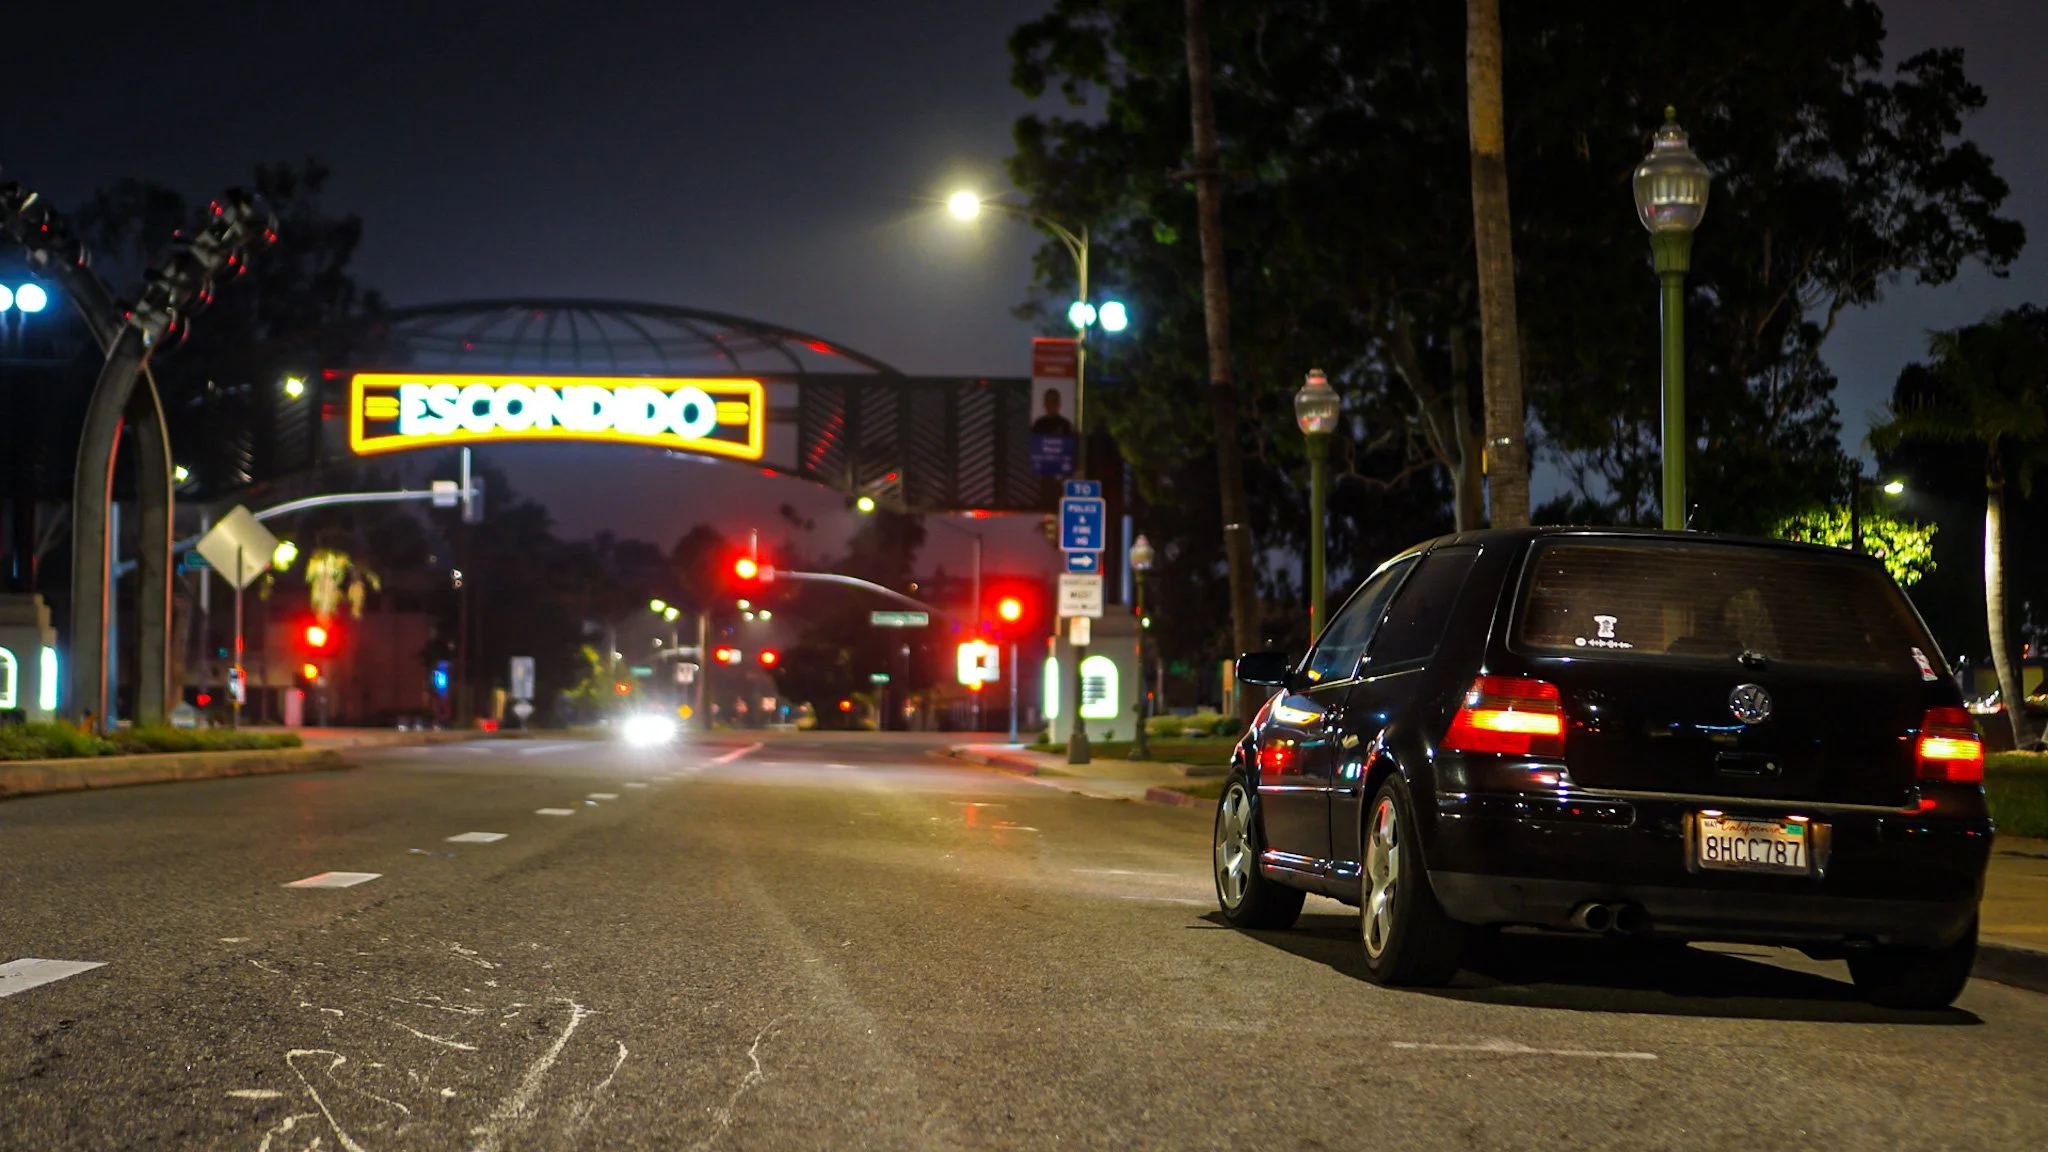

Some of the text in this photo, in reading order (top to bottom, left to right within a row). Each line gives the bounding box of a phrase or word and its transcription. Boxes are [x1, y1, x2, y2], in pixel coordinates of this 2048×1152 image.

[399, 382, 717, 440] ESCONDIDO
[1074, 483, 1092, 495] TO
[1721, 819, 1786, 836] California
[1706, 835, 1800, 866] 8HCC787
